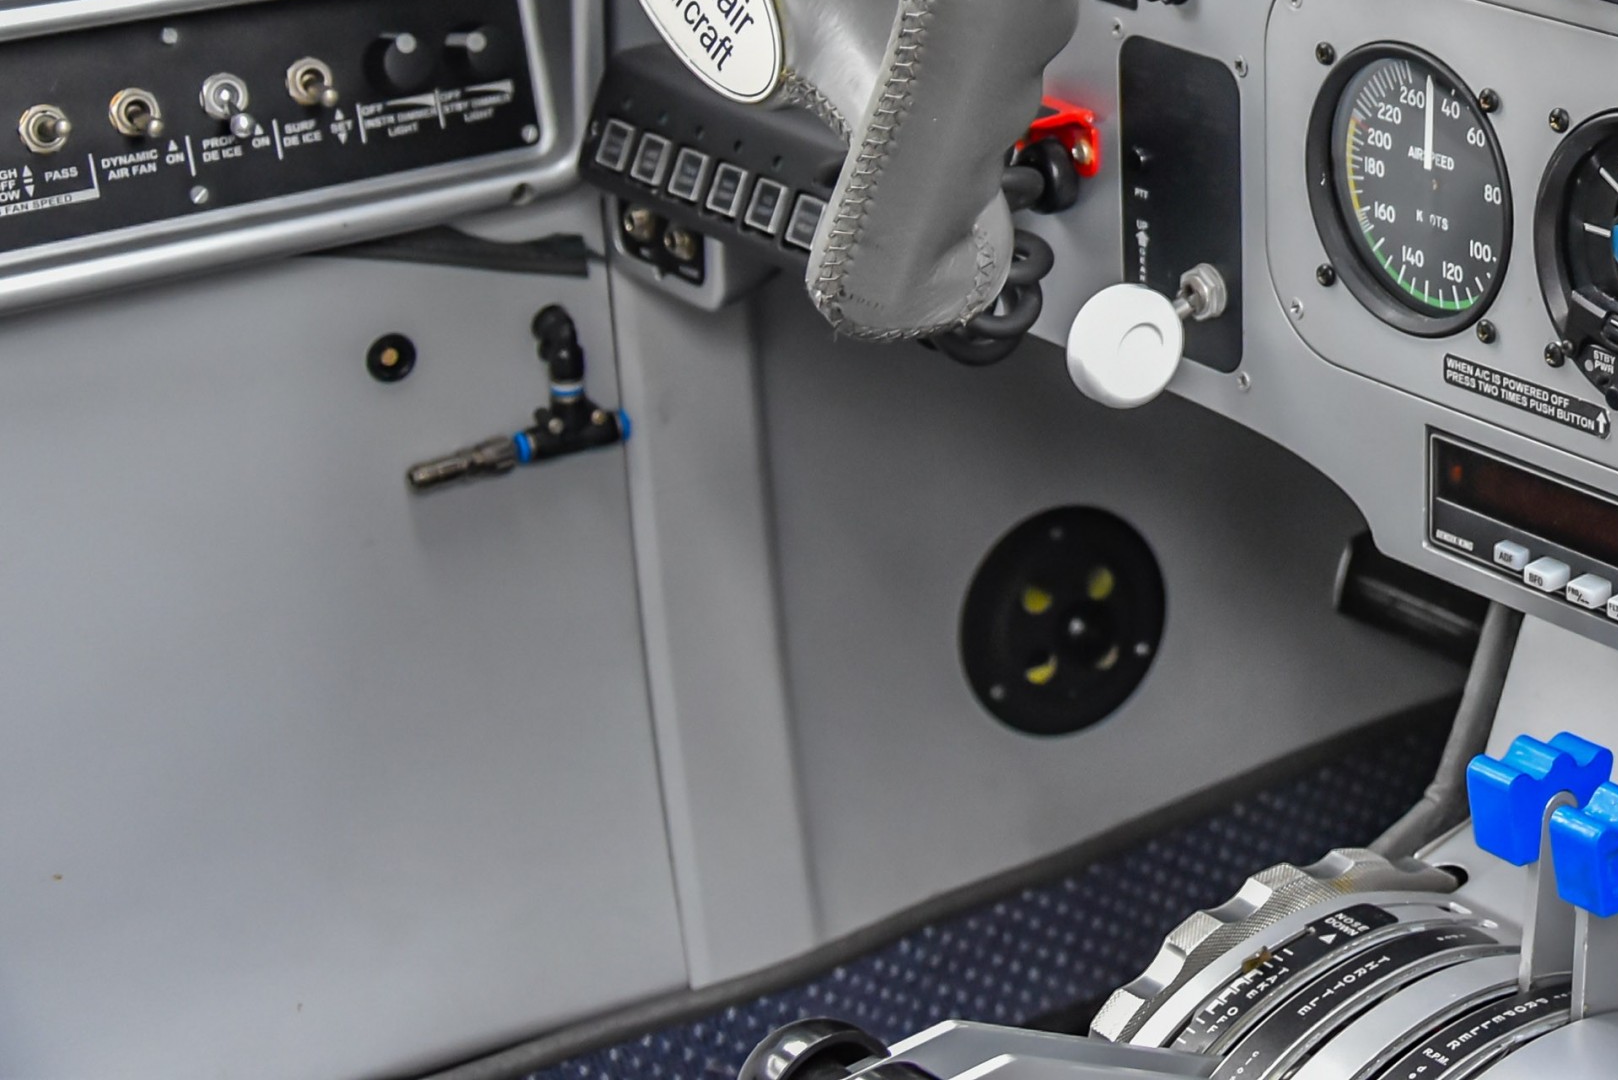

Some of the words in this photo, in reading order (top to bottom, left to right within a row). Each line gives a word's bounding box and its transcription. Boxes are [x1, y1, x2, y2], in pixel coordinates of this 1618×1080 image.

[1399, 86, 1425, 109] 260
[1377, 103, 1401, 124] 220
[1441, 99, 1460, 119] 40
[284, 119, 316, 135] SURF
[1467, 127, 1486, 148] 60
[252, 135, 270, 149] ON
[283, 135, 300, 148] DE
[302, 130, 322, 143] ICE
[1367, 128, 1392, 150] 200
[101, 149, 158, 169] DYNAMIC
[166, 151, 185, 165] ON
[203, 149, 219, 163] DE
[222, 144, 243, 159] ICE
[45, 166, 78, 183] PASS
[108, 167, 130, 181] AIR
[131, 162, 157, 178] FAN
[1364, 156, 1385, 178] 180
[32, 194, 73, 210] SPEED
[1484, 184, 1502, 205] 80
[1374, 201, 1395, 223] 160
[1402, 245, 1424, 268] 140
[1469, 239, 1492, 262] 100
[1442, 260, 1463, 283] 120
[1593, 349, 1616, 365] STBY
[1446, 357, 1474, 375] WHEN
[1474, 365, 1491, 381] A/C
[1491, 372, 1501, 385] IS
[1502, 376, 1549, 402] POWERED
[1551, 394, 1570, 408] OFF
[1446, 369, 1476, 388] PRESS
[1478, 380, 1499, 396] TWO
[1500, 388, 1528, 408] TIMES
[1529, 400, 1555, 417] PUSH
[1557, 409, 1595, 431] BUTTON
[1529, 573, 1543, 586] BFO
[1324, 918, 1360, 937] DOWN
[1334, 913, 1370, 931] NOSE
[1246, 967, 1290, 1000] TAKE
[1297, 955, 1390, 1016] THROTTLE
[1206, 1006, 1239, 1034] OFF
[1446, 997, 1549, 1051] PROPELLER
